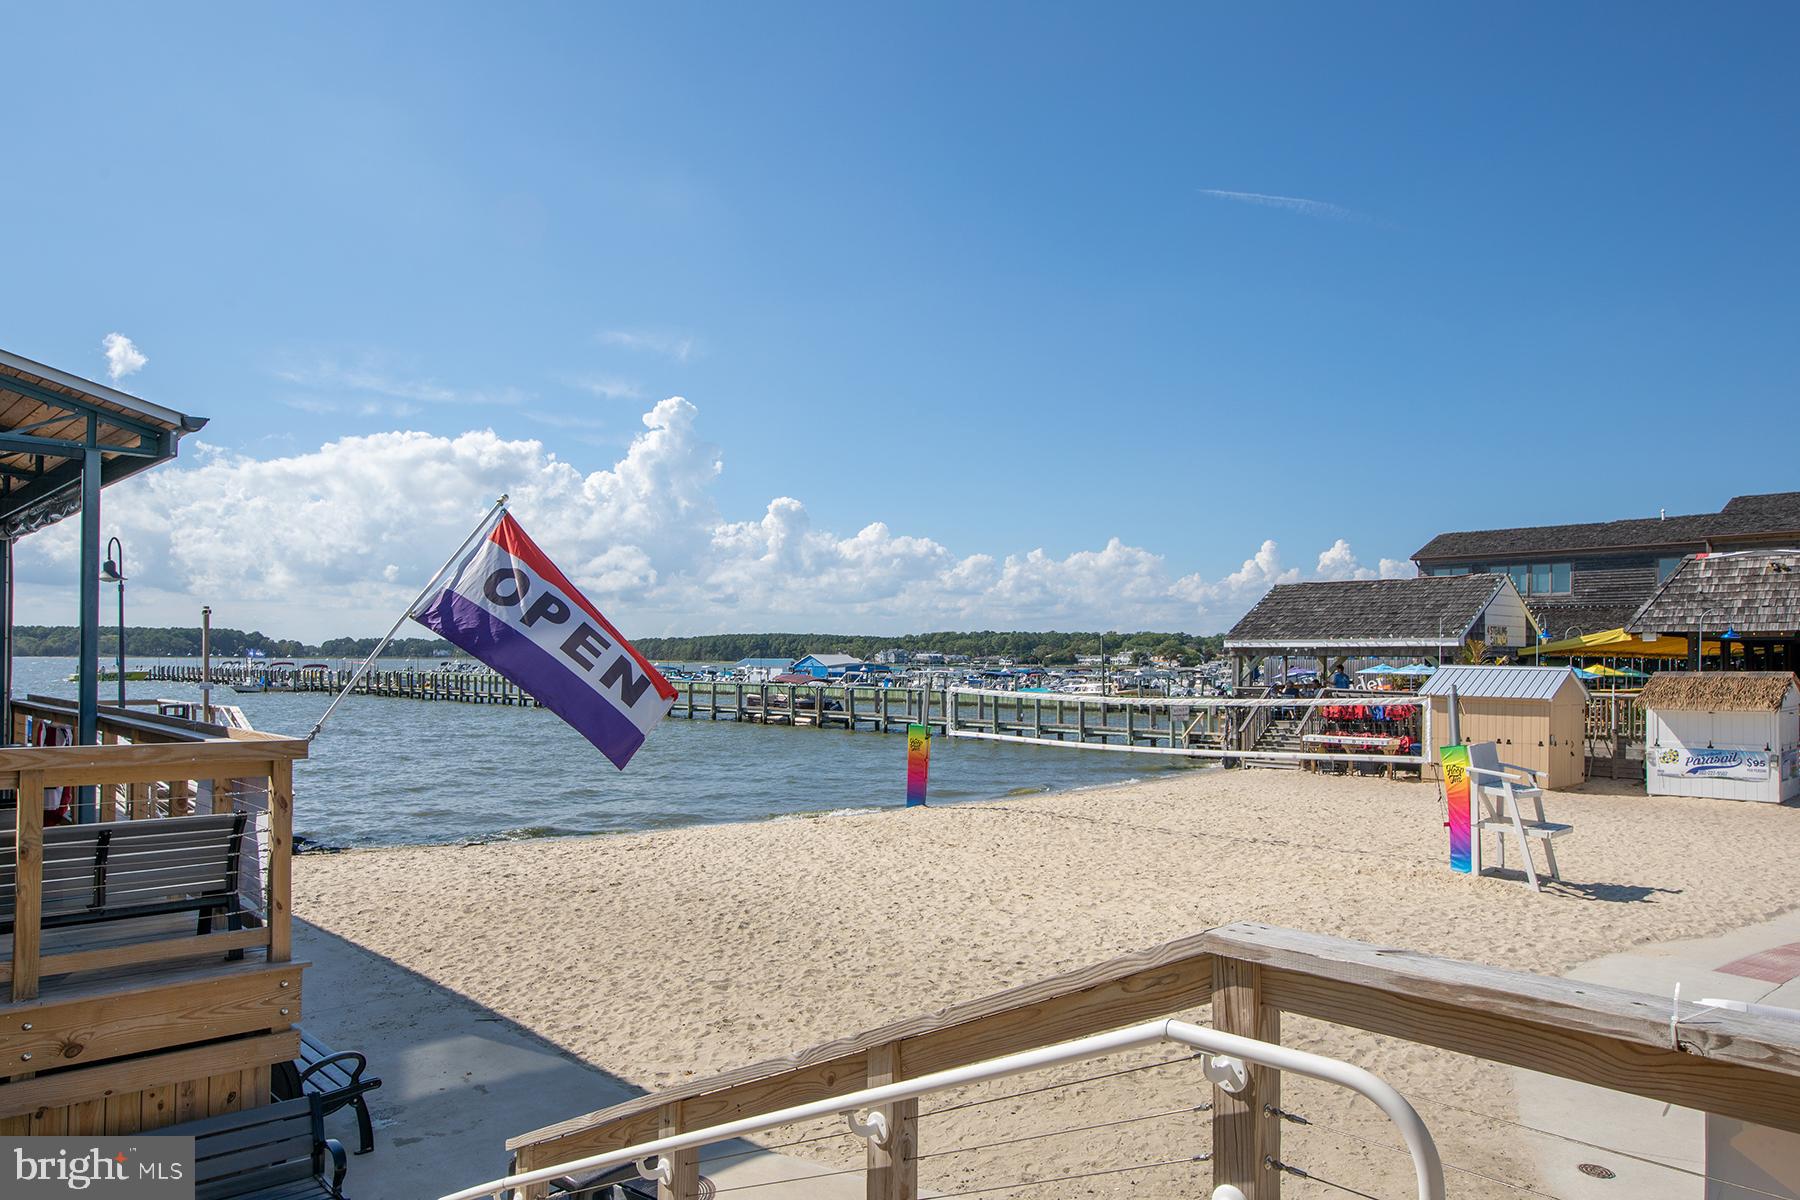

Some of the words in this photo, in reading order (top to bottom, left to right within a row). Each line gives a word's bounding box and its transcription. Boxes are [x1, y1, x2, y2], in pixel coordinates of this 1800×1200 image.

[483, 568, 651, 708] OPEN
[1685, 752, 1738, 767] Parasail
[1746, 757, 1766, 768] $95
